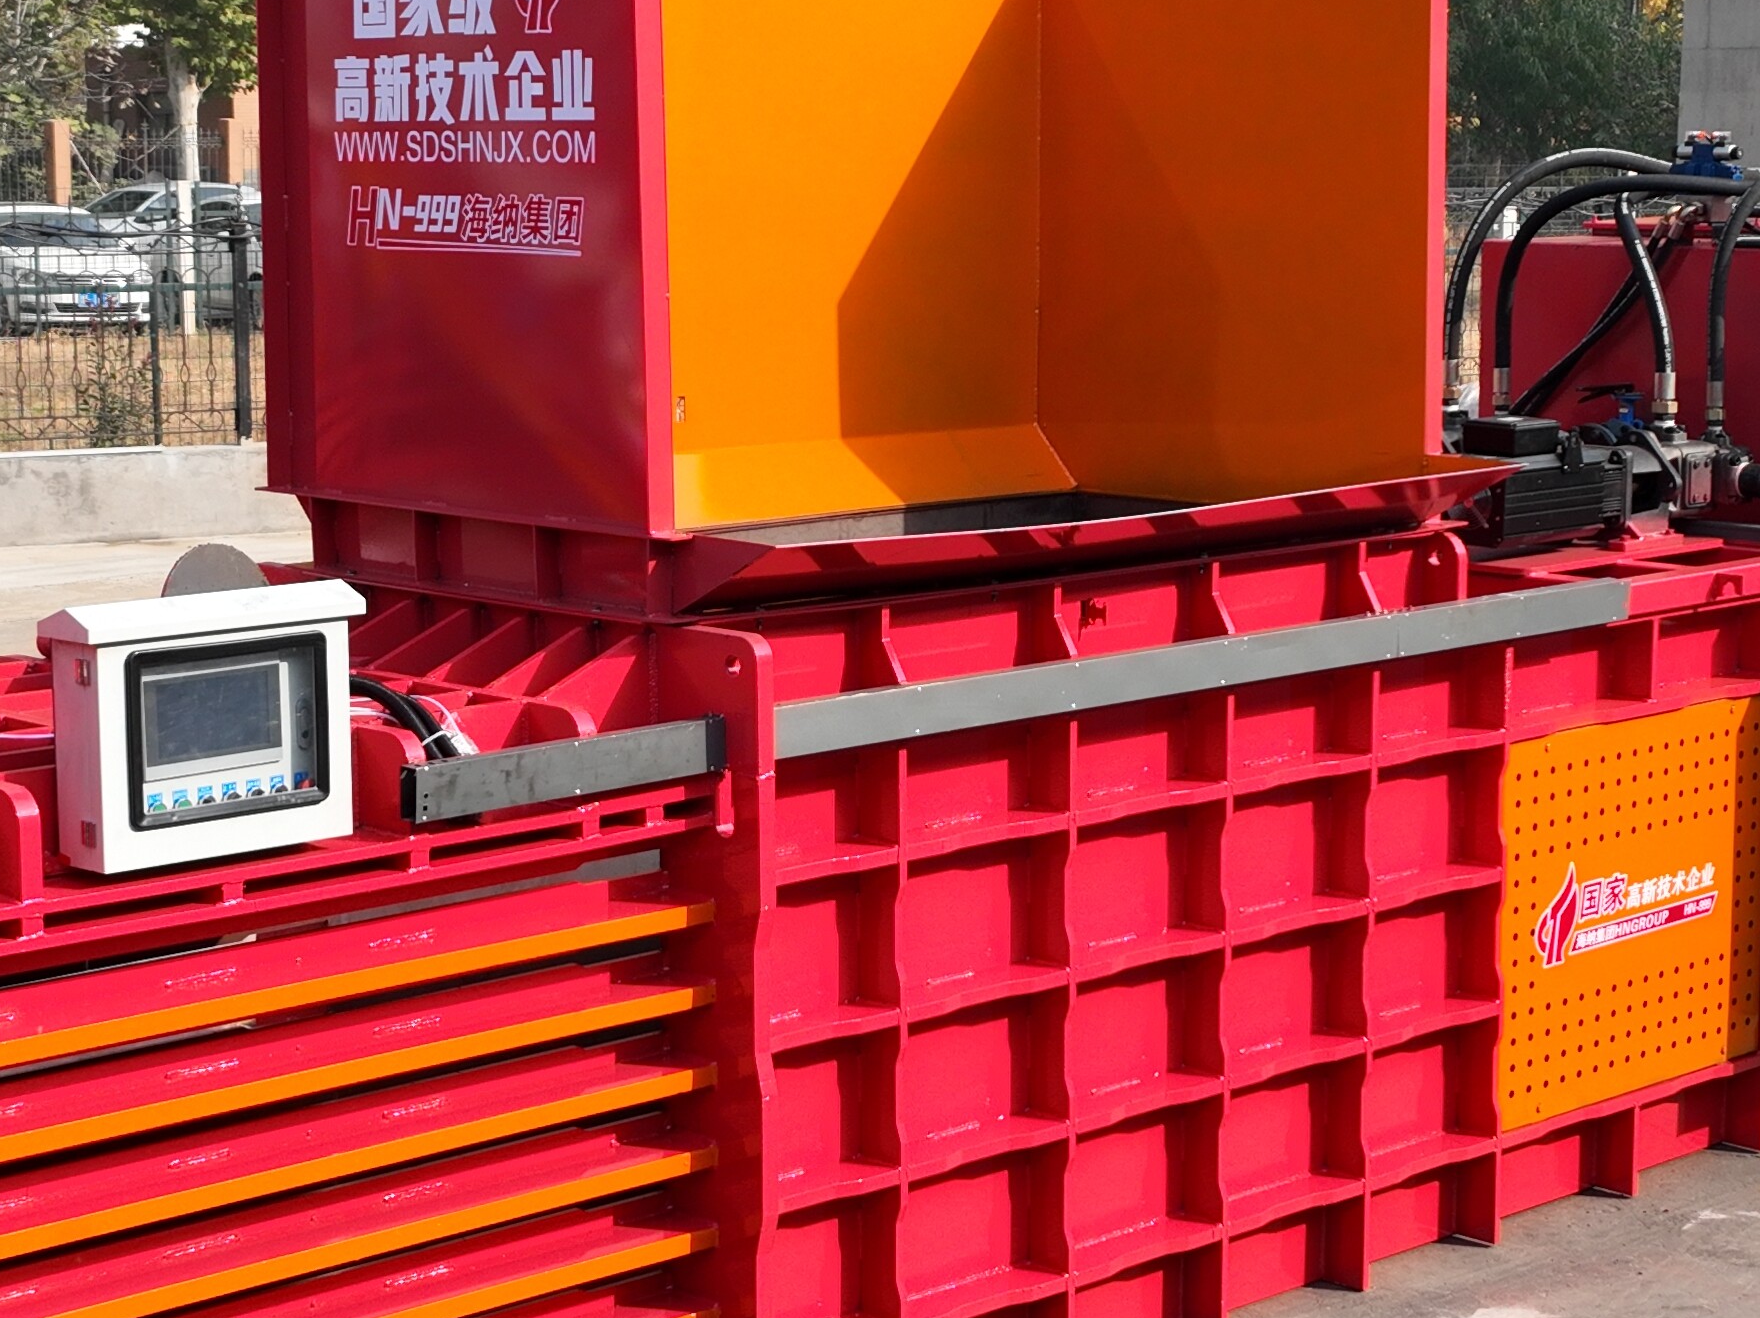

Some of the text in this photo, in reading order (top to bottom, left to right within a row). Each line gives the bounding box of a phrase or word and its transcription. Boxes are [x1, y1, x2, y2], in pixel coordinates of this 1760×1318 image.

[333, 45, 596, 126] 高新技术企业
[334, 129, 597, 164] WWW.SDSHNJX.COM
